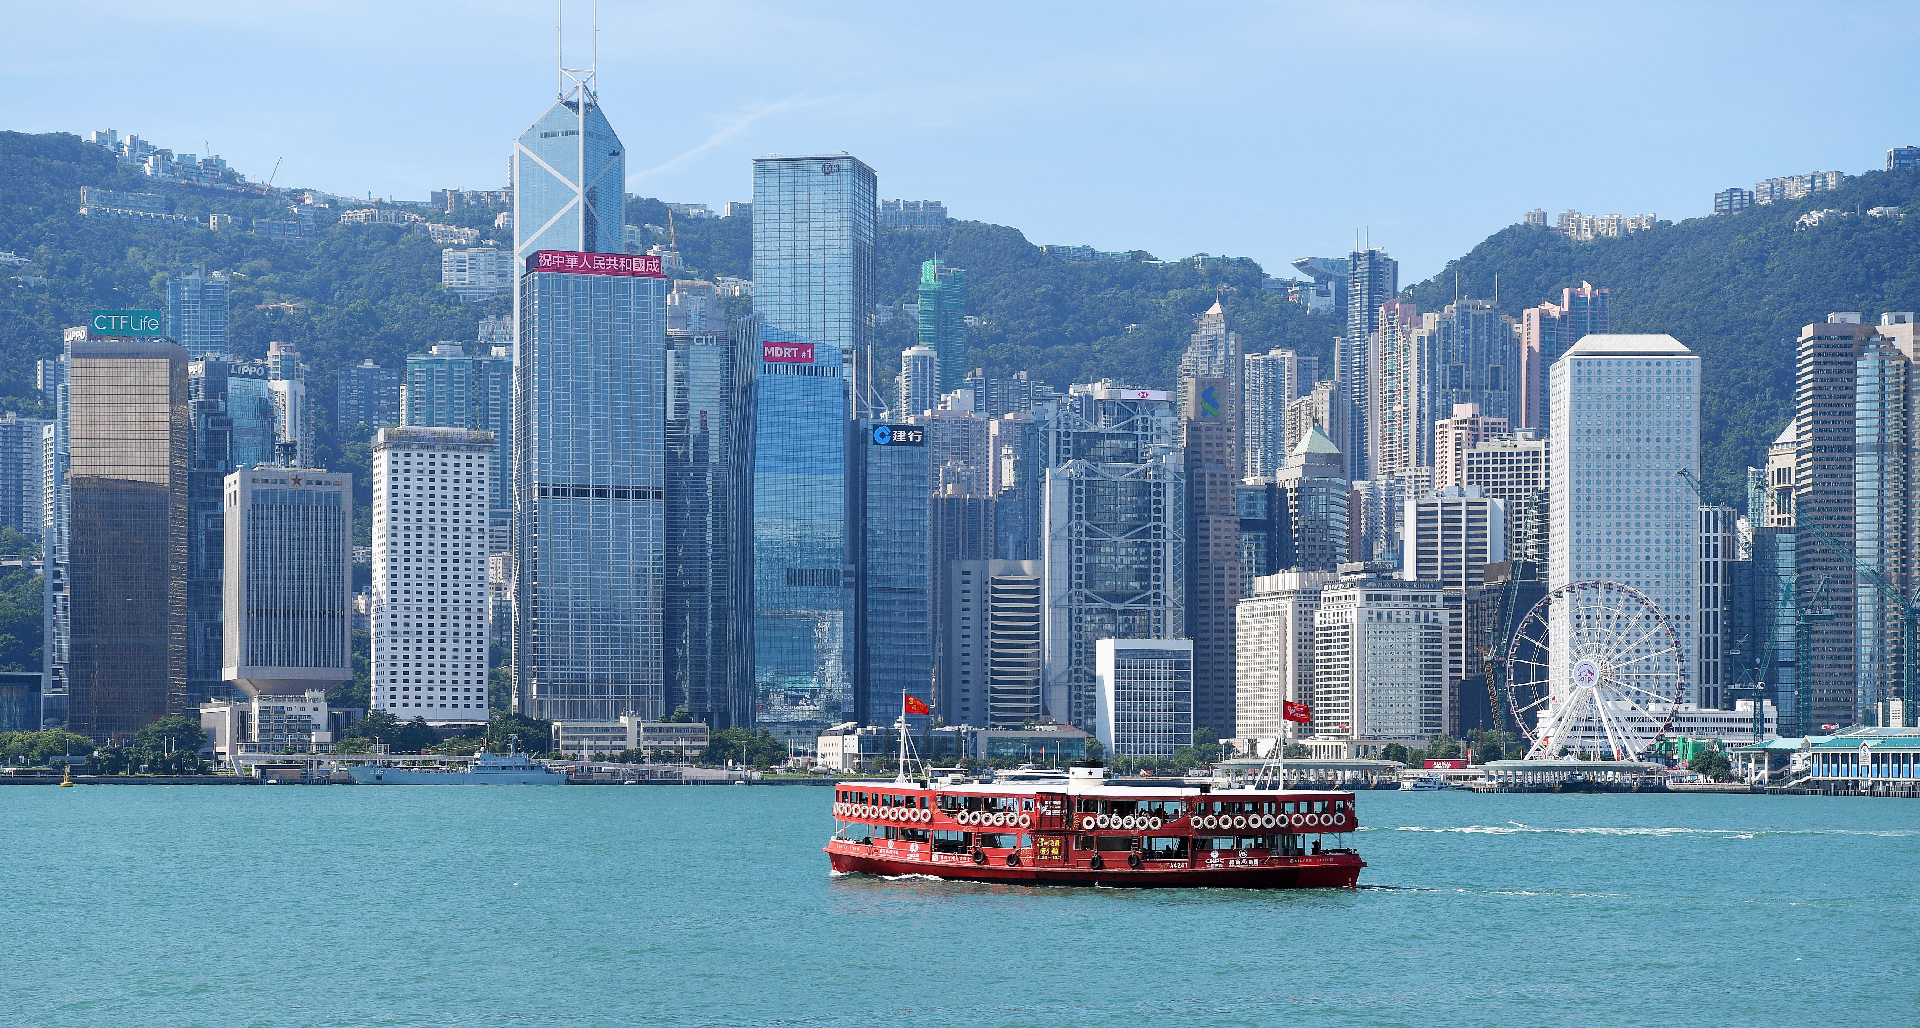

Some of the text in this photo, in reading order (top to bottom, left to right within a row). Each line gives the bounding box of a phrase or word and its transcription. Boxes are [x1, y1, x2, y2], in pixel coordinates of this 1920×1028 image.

[538, 252, 660, 273] 祝中華人民共和國成
[65, 330, 86, 341] LIPPO
[693, 333, 717, 347] citi
[764, 346, 812, 359] MDRT #1
[188, 364, 203, 375] PPO
[230, 364, 265, 377] LIPPO
[892, 430, 923, 442] 建行
